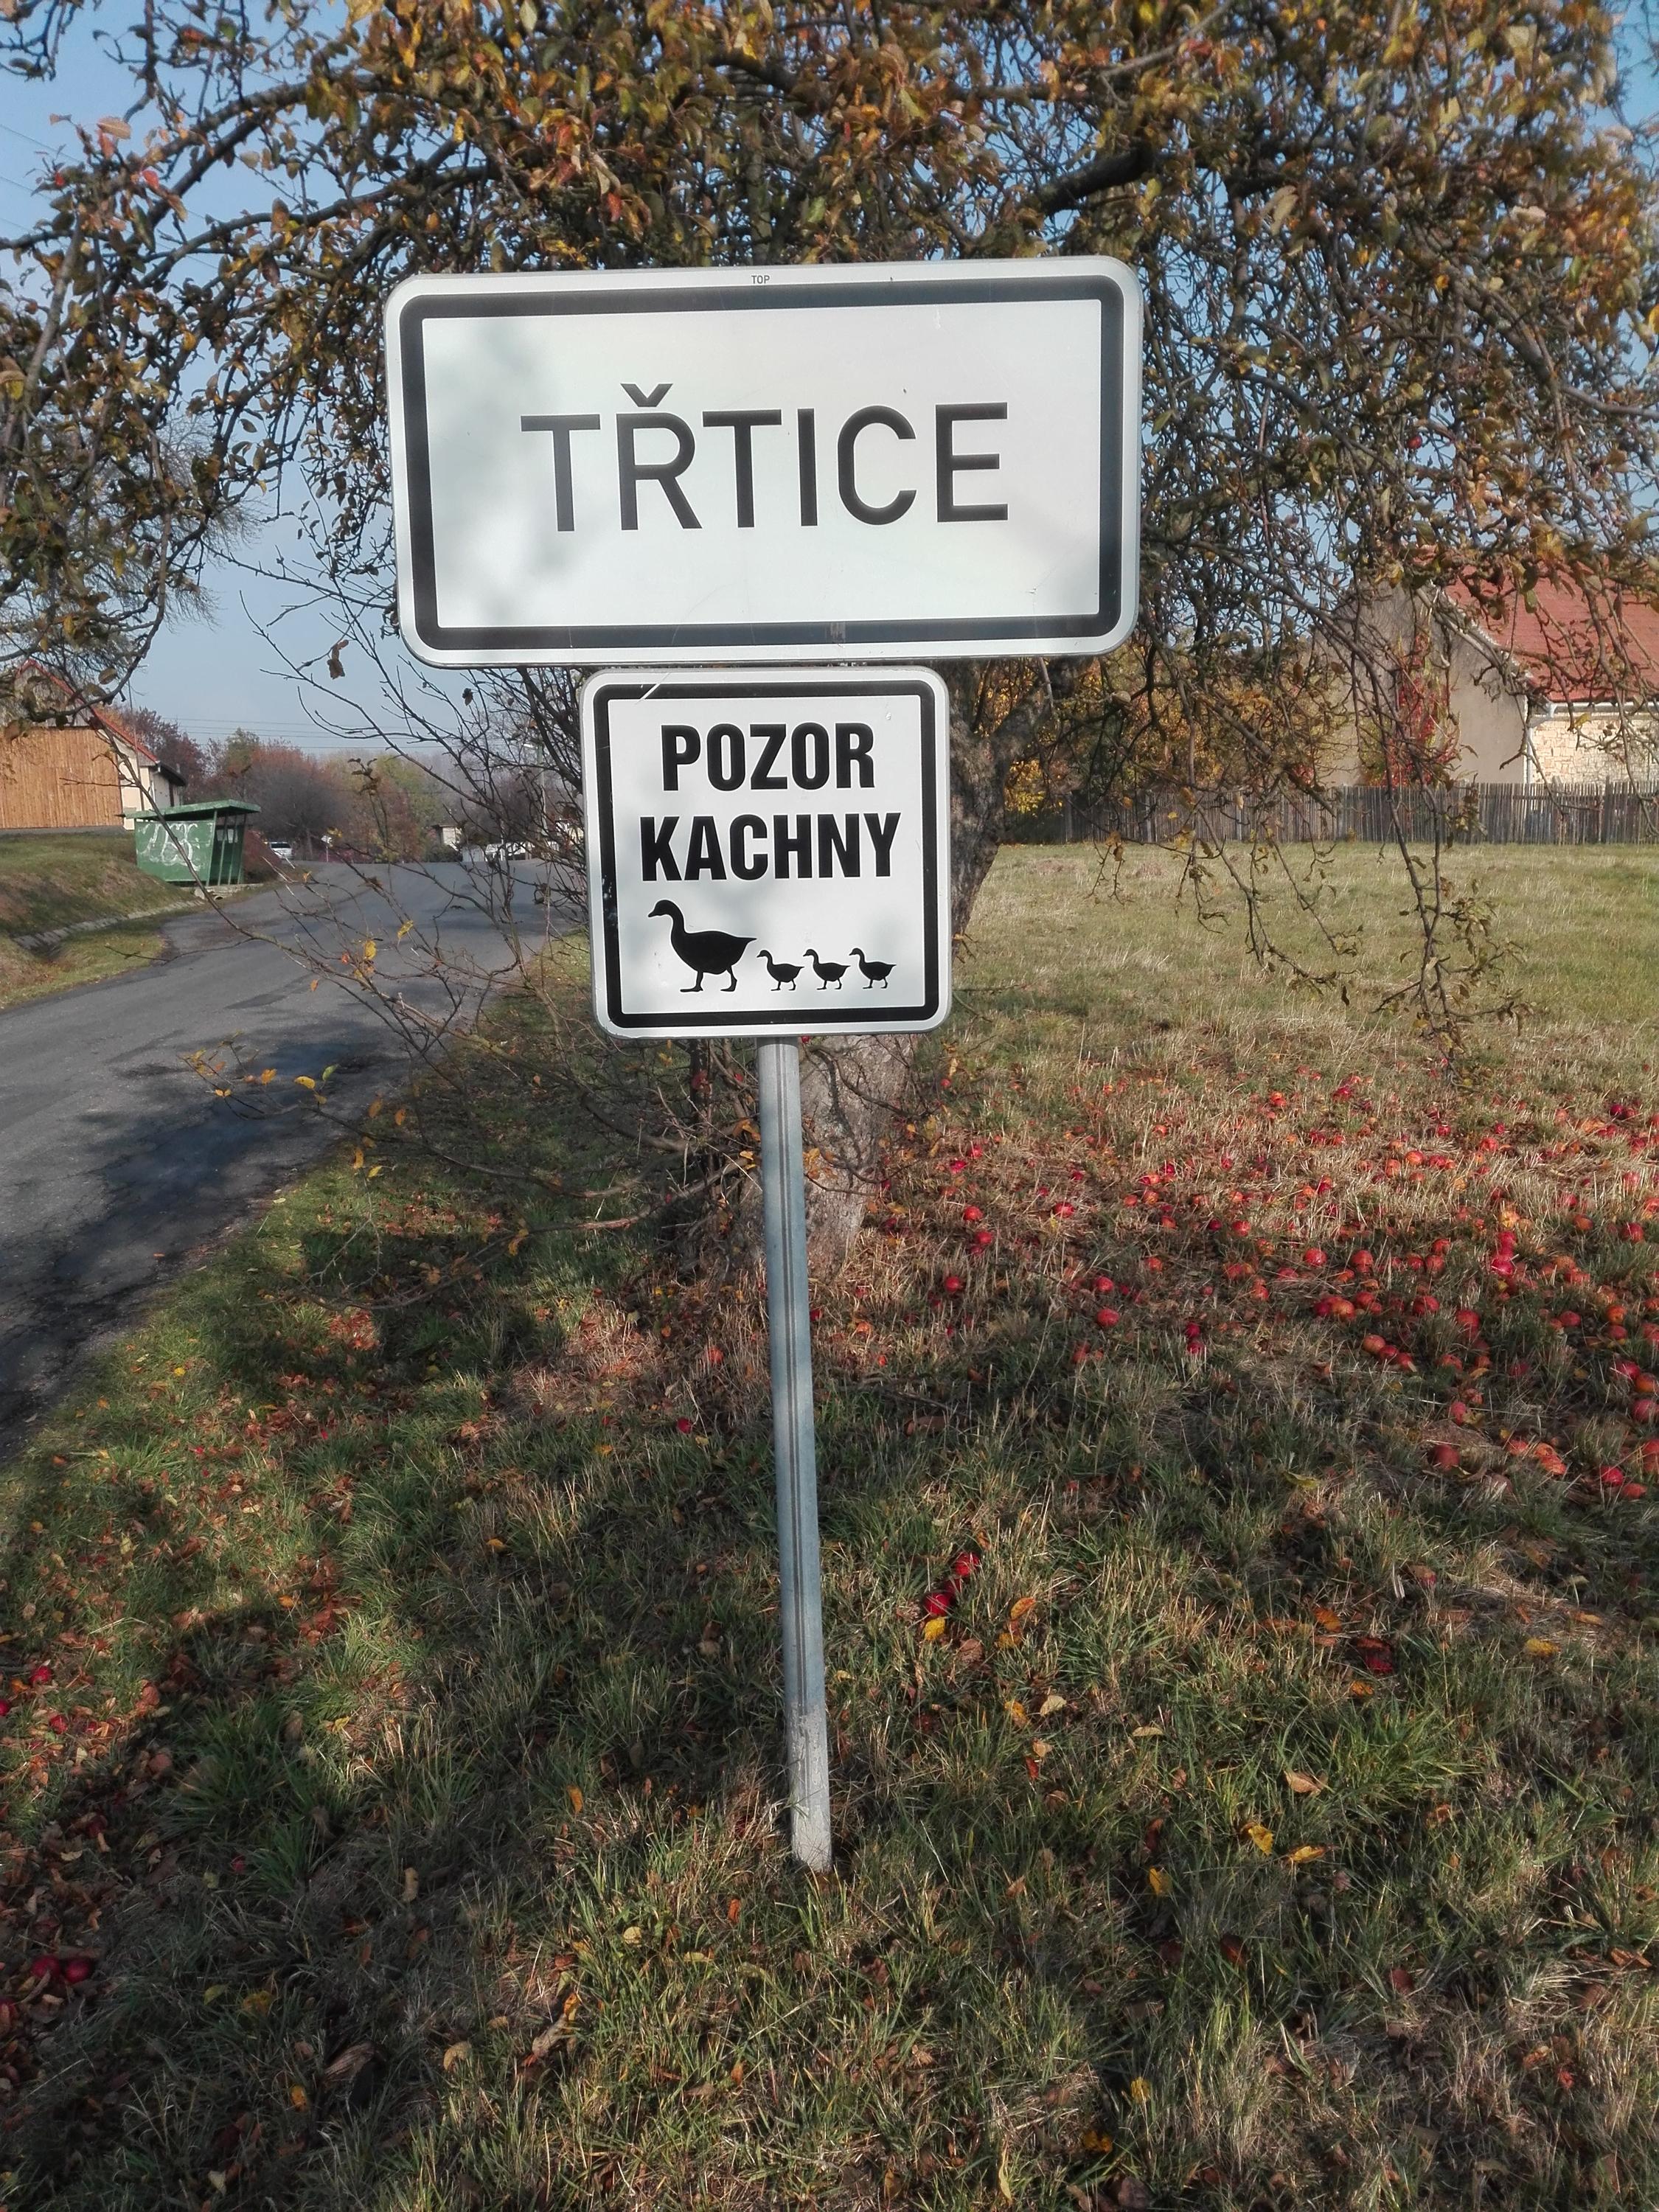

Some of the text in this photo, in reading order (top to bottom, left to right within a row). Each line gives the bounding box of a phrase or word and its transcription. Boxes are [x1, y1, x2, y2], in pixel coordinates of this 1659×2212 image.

[751, 275, 771, 285] TOP
[520, 383, 1008, 532] TŘTICE
[661, 722, 876, 791] POZOR
[640, 813, 901, 881] KACHNY
